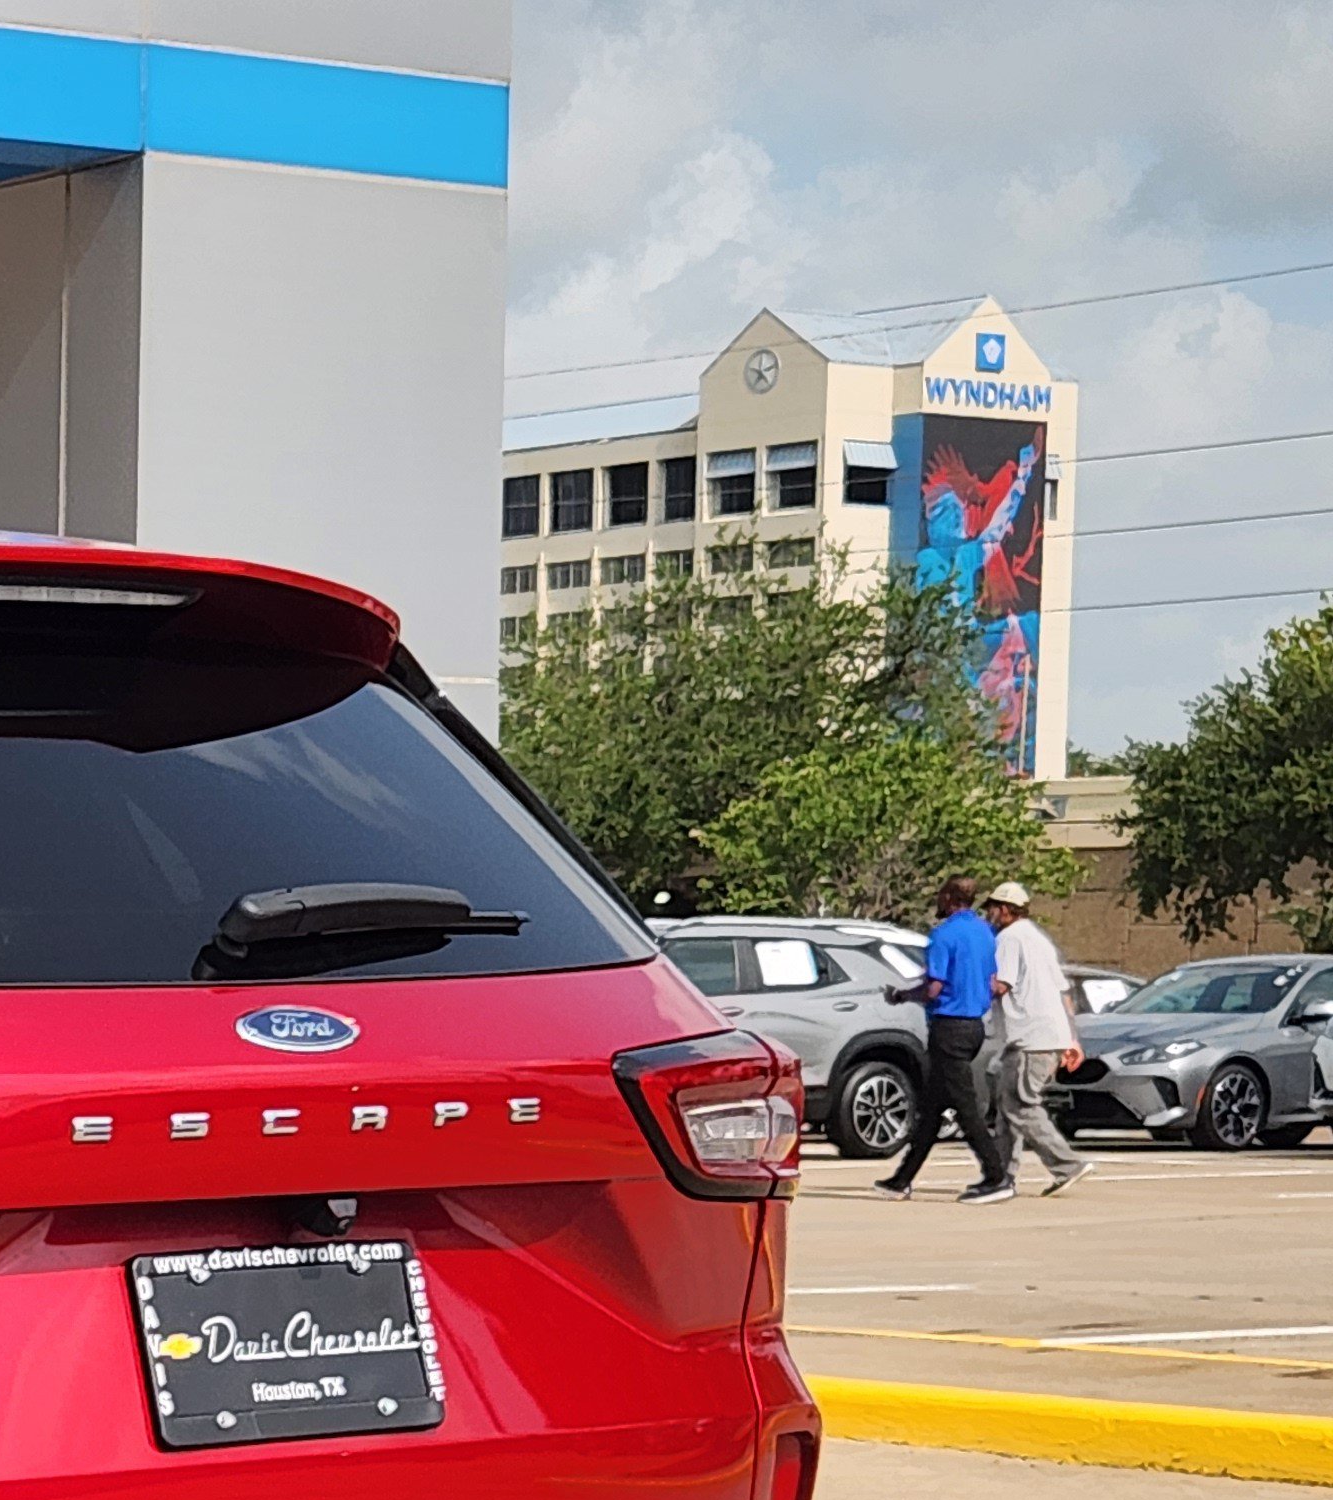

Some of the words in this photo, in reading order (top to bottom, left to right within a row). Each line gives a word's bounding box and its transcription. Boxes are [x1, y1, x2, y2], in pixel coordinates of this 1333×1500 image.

[925, 377, 1053, 412] WYNDHAM
[270, 1012, 334, 1037] Ford
[71, 1097, 543, 1143] ESCAPE
[153, 1243, 402, 1274] www.davischevrolet.com
[137, 1276, 175, 1416] DAVIS
[201, 1315, 288, 1363] Davis
[284, 1311, 421, 1358] Chevrolet
[252, 1381, 321, 1403] Houston,
[320, 1376, 347, 1397] TX
